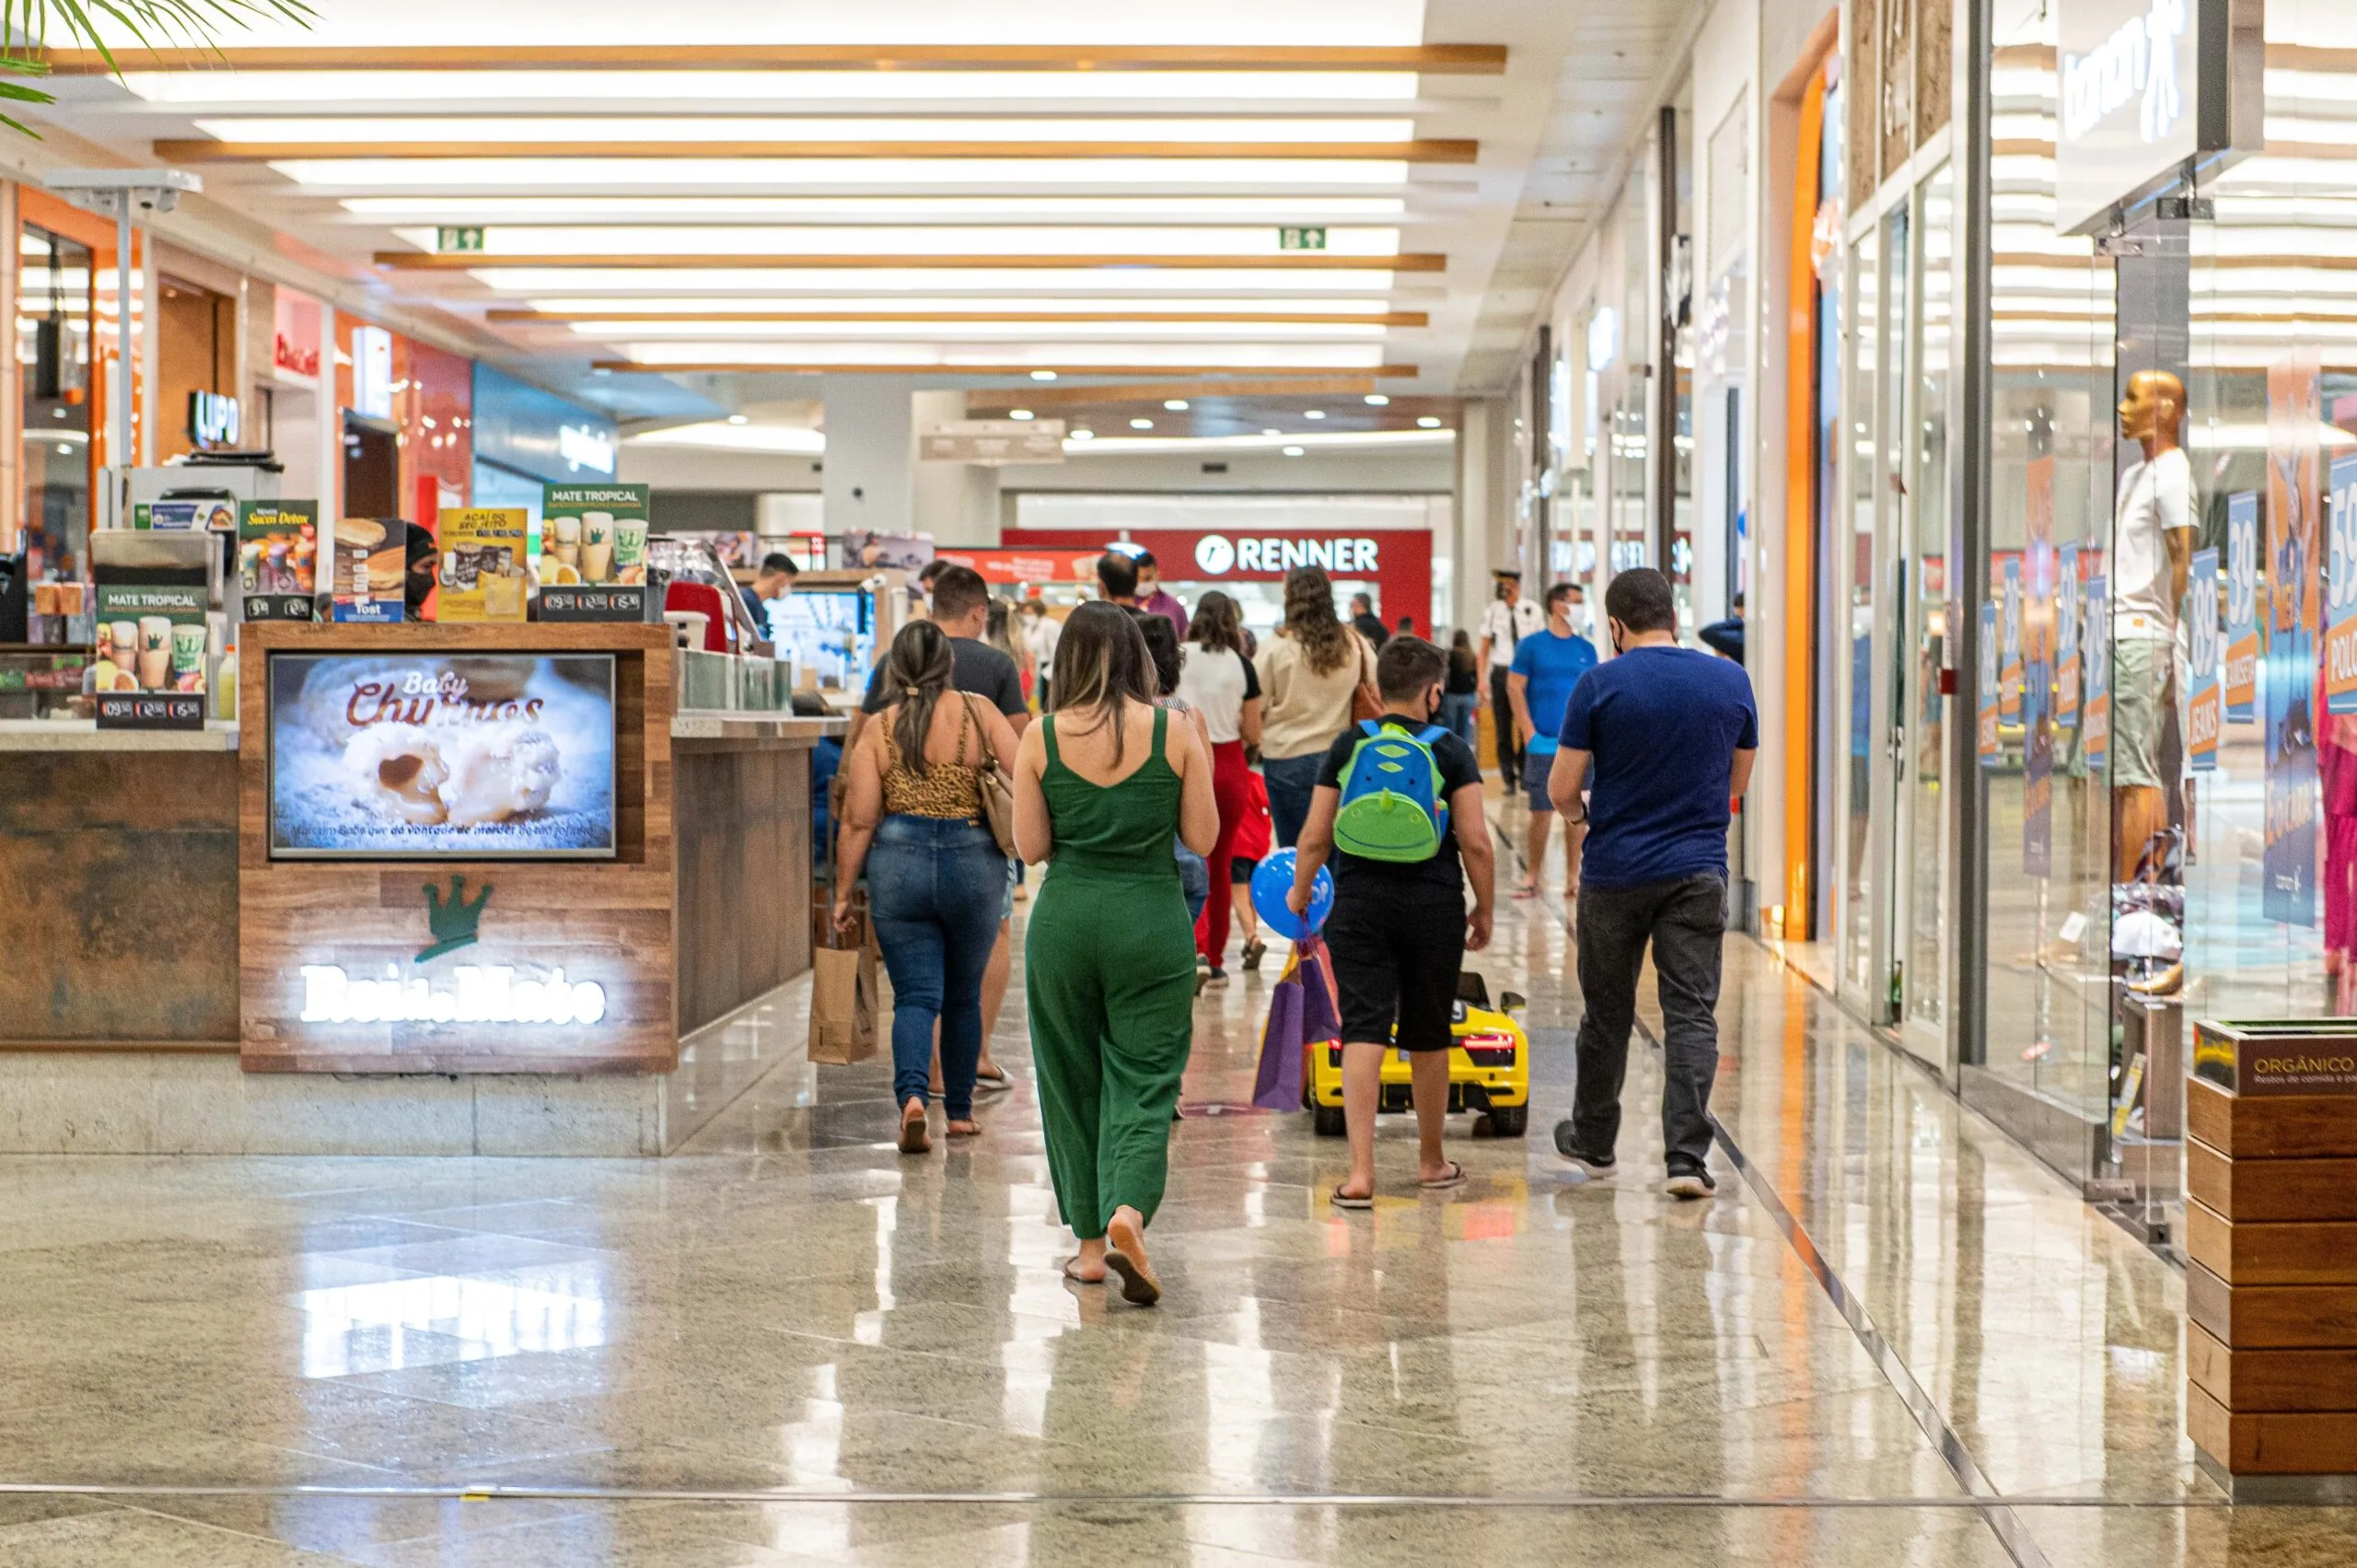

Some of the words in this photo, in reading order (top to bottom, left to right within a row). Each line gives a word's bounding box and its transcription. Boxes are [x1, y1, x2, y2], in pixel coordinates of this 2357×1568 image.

[552, 491, 582, 502] MATE
[585, 491, 638, 502] TROPICAL
[1237, 538, 1379, 572] RENNER
[2228, 519, 2256, 626] 39
[108, 593, 139, 606] MATE
[142, 594, 196, 607] TROPICAL
[2192, 575, 2217, 678] 89
[402, 670, 469, 702] Baby
[2190, 699, 2217, 747] JEANS
[2253, 1054, 2355, 1074] ORGÂNICO
